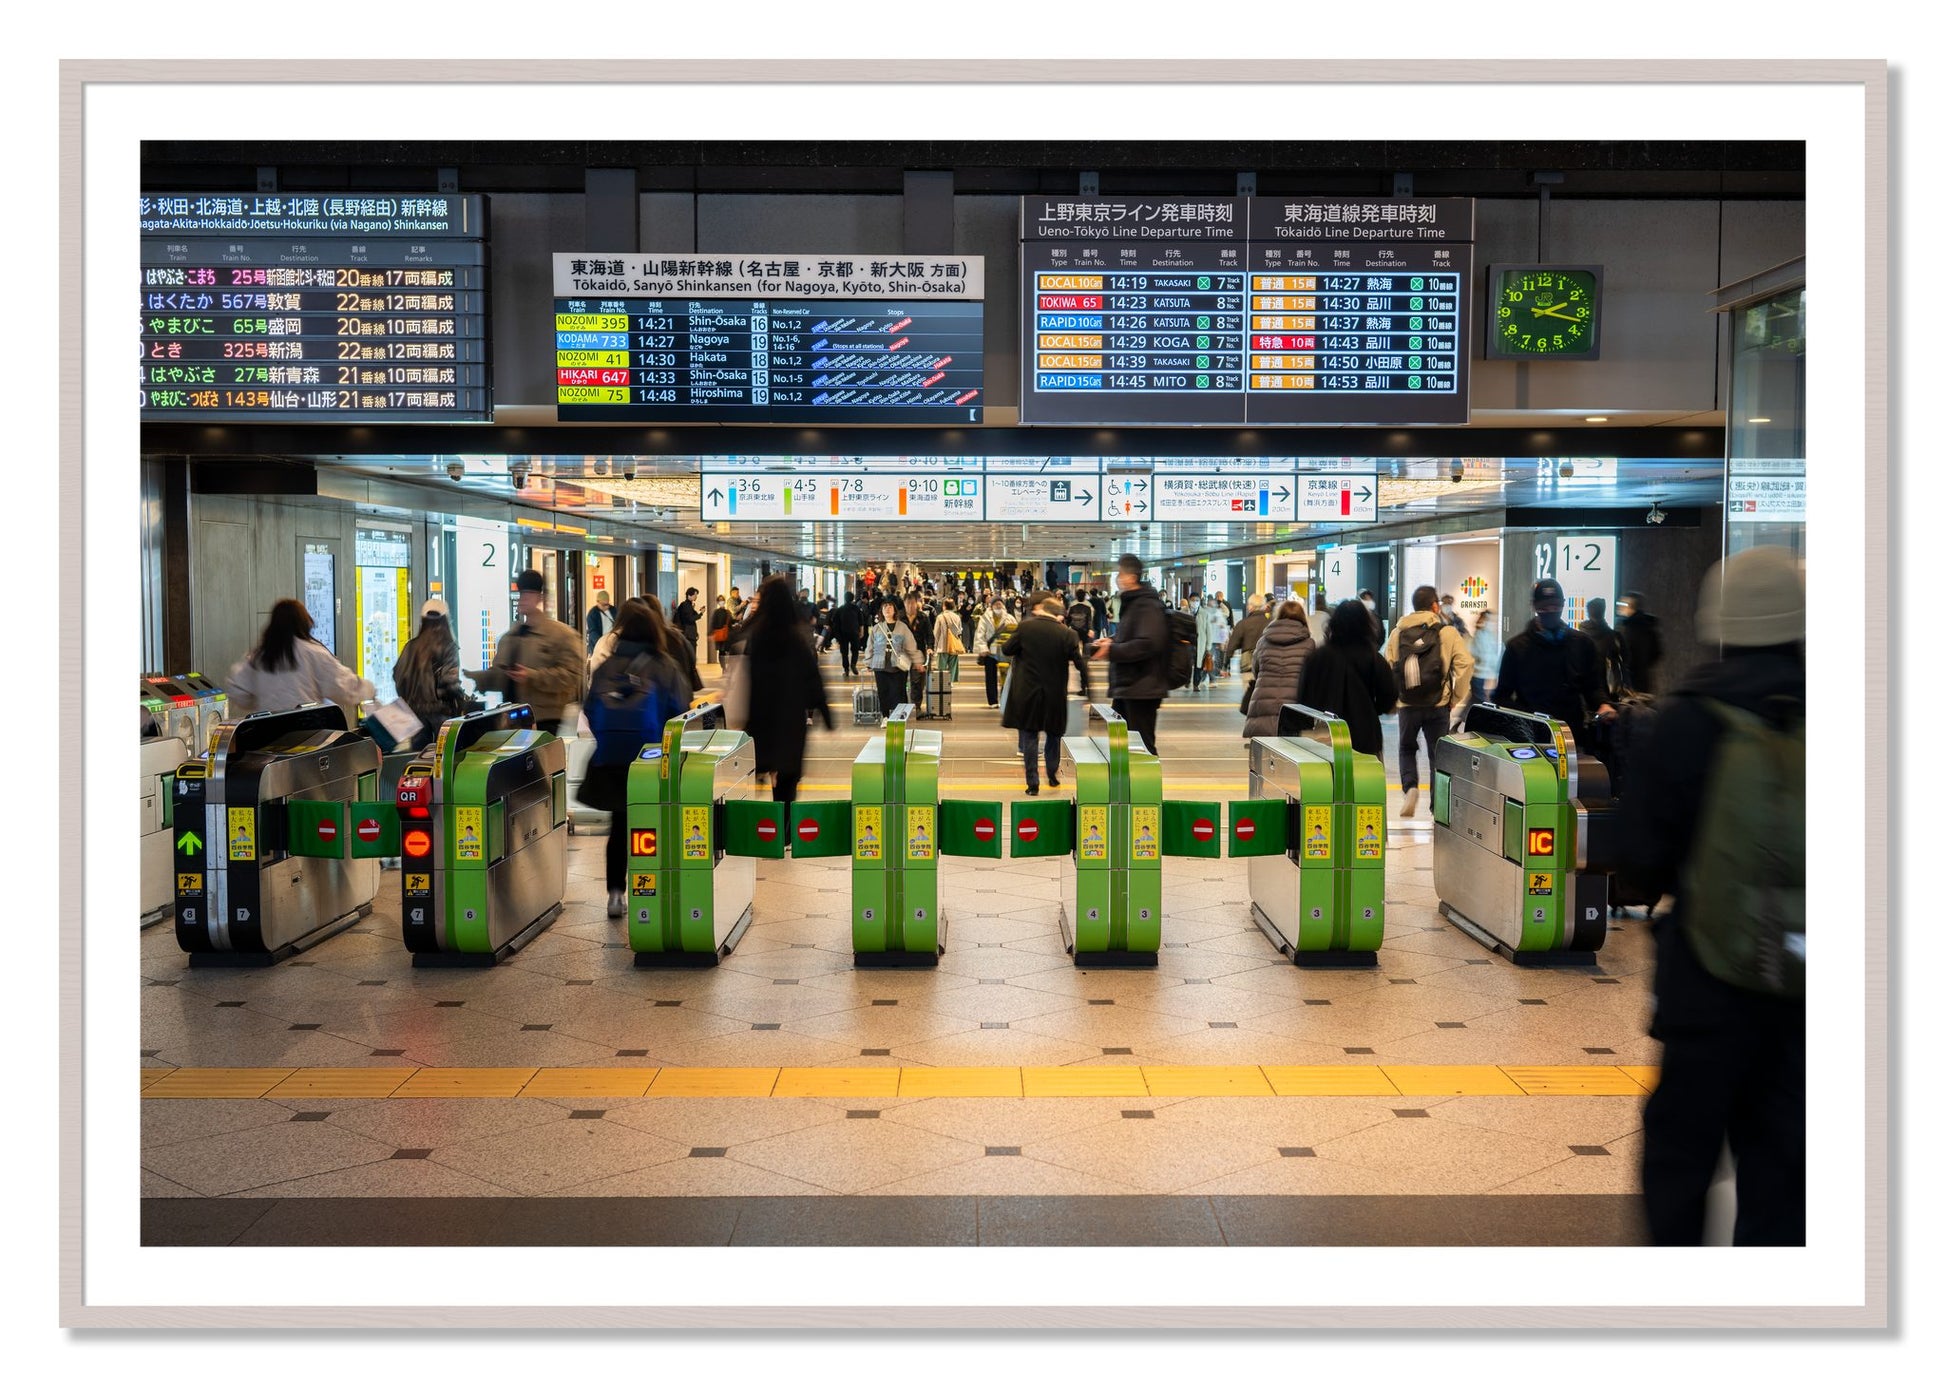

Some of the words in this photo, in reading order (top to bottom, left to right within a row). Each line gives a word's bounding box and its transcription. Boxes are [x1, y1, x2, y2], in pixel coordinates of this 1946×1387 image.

[1038, 203, 1233, 222] 上野東京ライン発車時刻
[1284, 204, 1436, 223] 東海道線発車時刻
[331, 219, 348, 231] (via
[350, 219, 391, 231] Nagano)
[394, 219, 449, 230] Shinkansen
[1038, 226, 1110, 239] Ueno-Tōkyō
[1112, 226, 1137, 237] Line
[1141, 226, 1202, 239] Departure
[1205, 226, 1234, 237] Time
[1275, 226, 1322, 237] Tōkaidō
[1325, 227, 1350, 238] Line
[1353, 227, 1414, 239] Departure
[1417, 227, 1446, 238] Time
[280, 254, 319, 262] Destination
[573, 279, 630, 292] Tōkaidō,
[634, 279, 673, 293] Sanyō
[677, 280, 751, 292] Shinkansen
[757, 280, 781, 293] (for
[785, 281, 839, 295] Nagoya,
[842, 281, 885, 294] Kyōto,
[889, 280, 966, 294] Shin-Ōsaka)
[1110, 277, 1147, 290] 14:19
[1154, 279, 1191, 287] TAKASAKI
[1259, 277, 1285, 290] 普通
[1323, 277, 1360, 290] 14:27
[1366, 277, 1392, 291] 熱海
[1537, 276, 1552, 287] 12
[1041, 297, 1077, 308] TOKIWA
[1109, 296, 1147, 309] 14:23
[1153, 298, 1191, 308] KATSUTA
[1322, 297, 1360, 310] 14:30
[1366, 297, 1391, 310] 品川
[1500, 307, 1511, 318] 9
[1576, 307, 1586, 318] 3
[557, 316, 598, 325] NOZOMI
[601, 317, 626, 330] 395
[638, 317, 673, 330] 14:21
[689, 316, 746, 326] Shin-Ōsaka
[752, 318, 766, 331] 16
[772, 320, 802, 330] No.1,2
[1109, 316, 1147, 329] 14:26
[1153, 317, 1191, 328] KATSUTA
[1322, 317, 1359, 330] 14:37
[1366, 317, 1391, 330] 熱海
[558, 334, 598, 343] KODAMA
[601, 335, 626, 347] 733
[638, 335, 675, 348] 14:27
[689, 335, 730, 345] Nagoya
[752, 335, 766, 348] 19
[1109, 336, 1147, 348] 14:29
[1153, 337, 1190, 348] KOGA
[1259, 336, 1284, 349] 特急
[1322, 337, 1359, 349] 14:43
[1366, 337, 1390, 349] 品川
[1537, 338, 1547, 349] 6
[558, 352, 599, 361] NOZOMI
[605, 353, 622, 365] 41
[639, 353, 675, 366] 14:30
[690, 352, 727, 362] Hakata
[752, 353, 767, 366] 18
[1109, 356, 1146, 368] 14:39
[1153, 358, 1190, 366] TAKASAKI
[1322, 356, 1358, 369] 14:50
[1365, 356, 1402, 369] 小田原
[560, 370, 598, 379] HIKARI
[602, 371, 627, 383] 647
[639, 371, 676, 383] 14:33
[690, 369, 747, 380] Shin-Ōsaka
[753, 371, 767, 384] 15
[773, 375, 803, 384] No.1-5
[1109, 375, 1146, 387] 14:45
[1153, 376, 1187, 387] MITO
[1321, 376, 1358, 388] 14:53
[1365, 376, 1389, 389] 品川
[559, 387, 600, 397] NOZOMI
[607, 389, 623, 401] 75
[639, 389, 676, 402] 14:48
[690, 387, 743, 398] Hiroshima
[1308, 480, 1338, 490] 京葉線
[1011, 488, 1048, 496] エレベーター
[944, 499, 974, 509] 新幹線
[482, 542, 496, 567] 2
[1331, 560, 1341, 576] 4
[1389, 554, 1396, 582] 3
[1460, 600, 1488, 609] GRANSTA
[400, 791, 417, 801] QR
[632, 832, 656, 854] IC
[1530, 832, 1553, 854] IC
[186, 910, 193, 919] 8
[239, 910, 246, 919] 7
[414, 910, 421, 919] 7
[466, 910, 473, 919] 6
[640, 910, 647, 919] 6
[866, 910, 872, 919] 5
[917, 910, 923, 919] 4
[1141, 910, 1148, 919] 3
[1364, 909, 1371, 918] 2
[1588, 910, 1594, 918] 1
